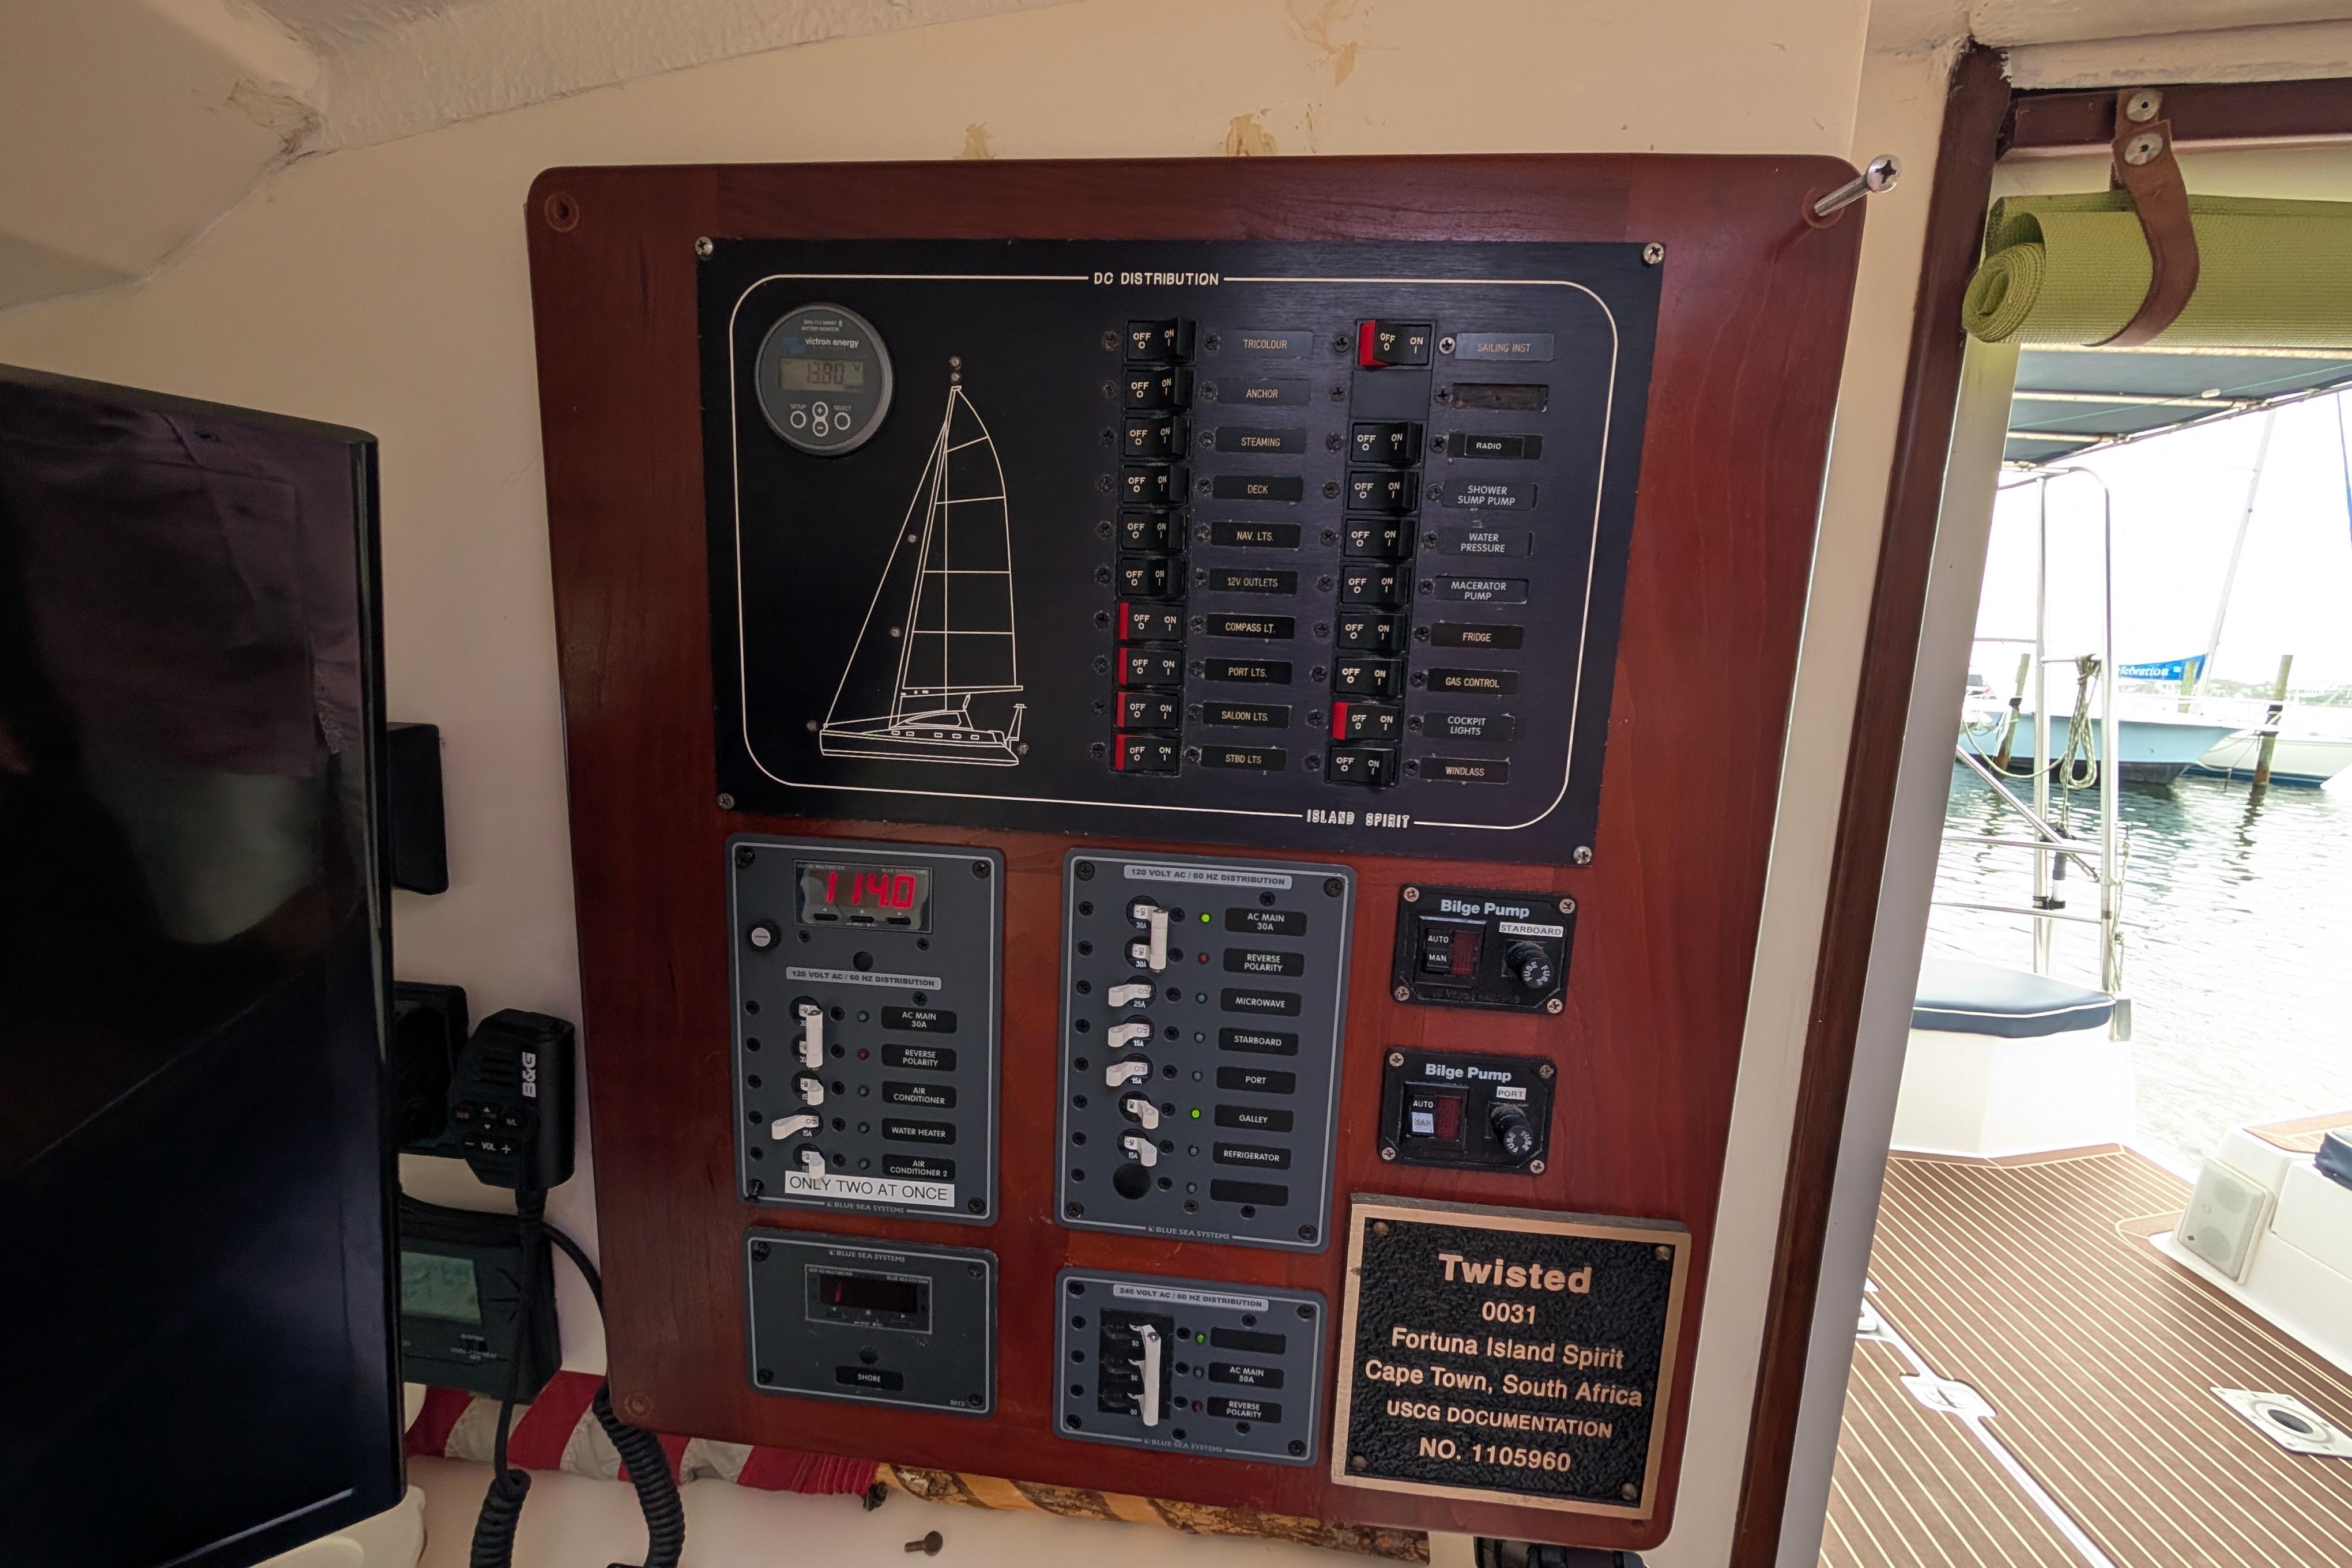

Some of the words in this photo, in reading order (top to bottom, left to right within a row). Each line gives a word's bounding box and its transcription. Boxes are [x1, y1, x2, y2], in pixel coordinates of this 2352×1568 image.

[1094, 273, 1113, 285] DC
[1121, 273, 1219, 285] DISTRIBUTION
[1164, 329, 1174, 338] ON
[1381, 333, 1395, 342] OFF
[805, 337, 830, 345] victron
[833, 340, 859, 348] energy
[1243, 339, 1287, 349] TRICOLOUR
[1477, 344, 1509, 352] SAILING
[1513, 344, 1531, 352] INST
[1246, 389, 1278, 398] ANCHOR
[1241, 438, 1280, 446] STEAMING
[1248, 485, 1268, 494] DECK
[1468, 485, 1507, 495] SHOWER
[1458, 496, 1485, 504] SUMP
[1488, 497, 1516, 506] PUMP
[1469, 533, 1499, 541] WATER
[1461, 544, 1505, 552] PRESSURE
[1228, 578, 1240, 586] 12V
[1244, 578, 1278, 587] OUTLETS
[1452, 582, 1506, 590] MACERATOR
[1226, 623, 1261, 632] COMPASS
[1264, 624, 1275, 633] LT.
[1463, 633, 1491, 642] FRIDGE
[1228, 668, 1248, 676] PORT
[1251, 668, 1267, 677] LTS.
[1446, 677, 1461, 686] GAS
[1464, 679, 1499, 688] CONTROL
[1222, 711, 1250, 720] SALOON
[1253, 713, 1269, 721] LTS.
[1448, 717, 1486, 726] COCKPIT
[1450, 726, 1481, 735] LIGHTS
[1226, 755, 1245, 763] STBD
[1247, 755, 1261, 764] LTS
[1446, 767, 1484, 776] WINDLASS
[1307, 810, 1354, 824] ISLAND
[1366, 813, 1409, 828] SPIRIT
[1221, 875, 1284, 885] DISTRIBUTION
[1441, 900, 1480, 916] Bilge
[1484, 902, 1529, 919] Pump
[1262, 914, 1284, 922] MAIN
[1501, 925, 1562, 935] STARBOARD
[1247, 955, 1280, 963] REVERSE
[1245, 963, 1283, 972] POLARITY
[1525, 962, 1537, 982] FUSE
[1536, 965, 1550, 986] FUSE
[876, 977, 934, 986] DISTRIBUTION
[1235, 998, 1285, 1008] MICROWAVE
[916, 1012, 936, 1020] MAIN
[1234, 1036, 1281, 1046] STARBOARD
[905, 1049, 936, 1058] REVERSE
[903, 1058, 938, 1066] POLARITY
[522, 1051, 536, 1097] B&G
[1425, 1064, 1464, 1080] Bilge
[1468, 1067, 1512, 1083] Pump
[894, 1094, 945, 1105] CONDITIONER
[1239, 1115, 1268, 1124] GALLEY
[892, 1127, 915, 1135] WATER
[918, 1129, 945, 1137] HEATER
[482, 1142, 496, 1151] VOL
[1224, 1150, 1279, 1162] REFRIGERATOR
[890, 1167, 940, 1175] CONDITIONER
[790, 1176, 831, 1190] ONLY
[836, 1180, 873, 1194] TWO
[877, 1182, 897, 1196] AT
[902, 1186, 947, 1200] ONCE
[1197, 1231, 1230, 1239] SYSTEMS
[875, 1254, 905, 1262] SYSTEMS
[1439, 1253, 1592, 1294] Twisted
[1203, 1296, 1262, 1307] DISTRIBUTION
[1482, 1302, 1536, 1325] 0031
[1392, 1328, 1477, 1355] Fortuna
[1488, 1337, 1555, 1363] Island
[1563, 1344, 1624, 1370] Spirit
[1243, 1367, 1264, 1377] MAIN
[858, 1374, 881, 1382] SHORE
[1239, 1375, 1254, 1383] 50A
[1366, 1360, 1423, 1386] Cape
[1431, 1367, 1493, 1394] Town,
[1503, 1375, 1567, 1399] South
[1575, 1383, 1642, 1407] Africa
[1229, 1401, 1260, 1410] REVERSE
[1227, 1409, 1262, 1418] POLARITY
[1386, 1400, 1440, 1420] USCG
[1448, 1408, 1612, 1438] DOCUMENTATION
[1191, 1444, 1222, 1452] SYSTEMS
[1419, 1438, 1461, 1460] NO.
[1472, 1445, 1571, 1472] 1105960
